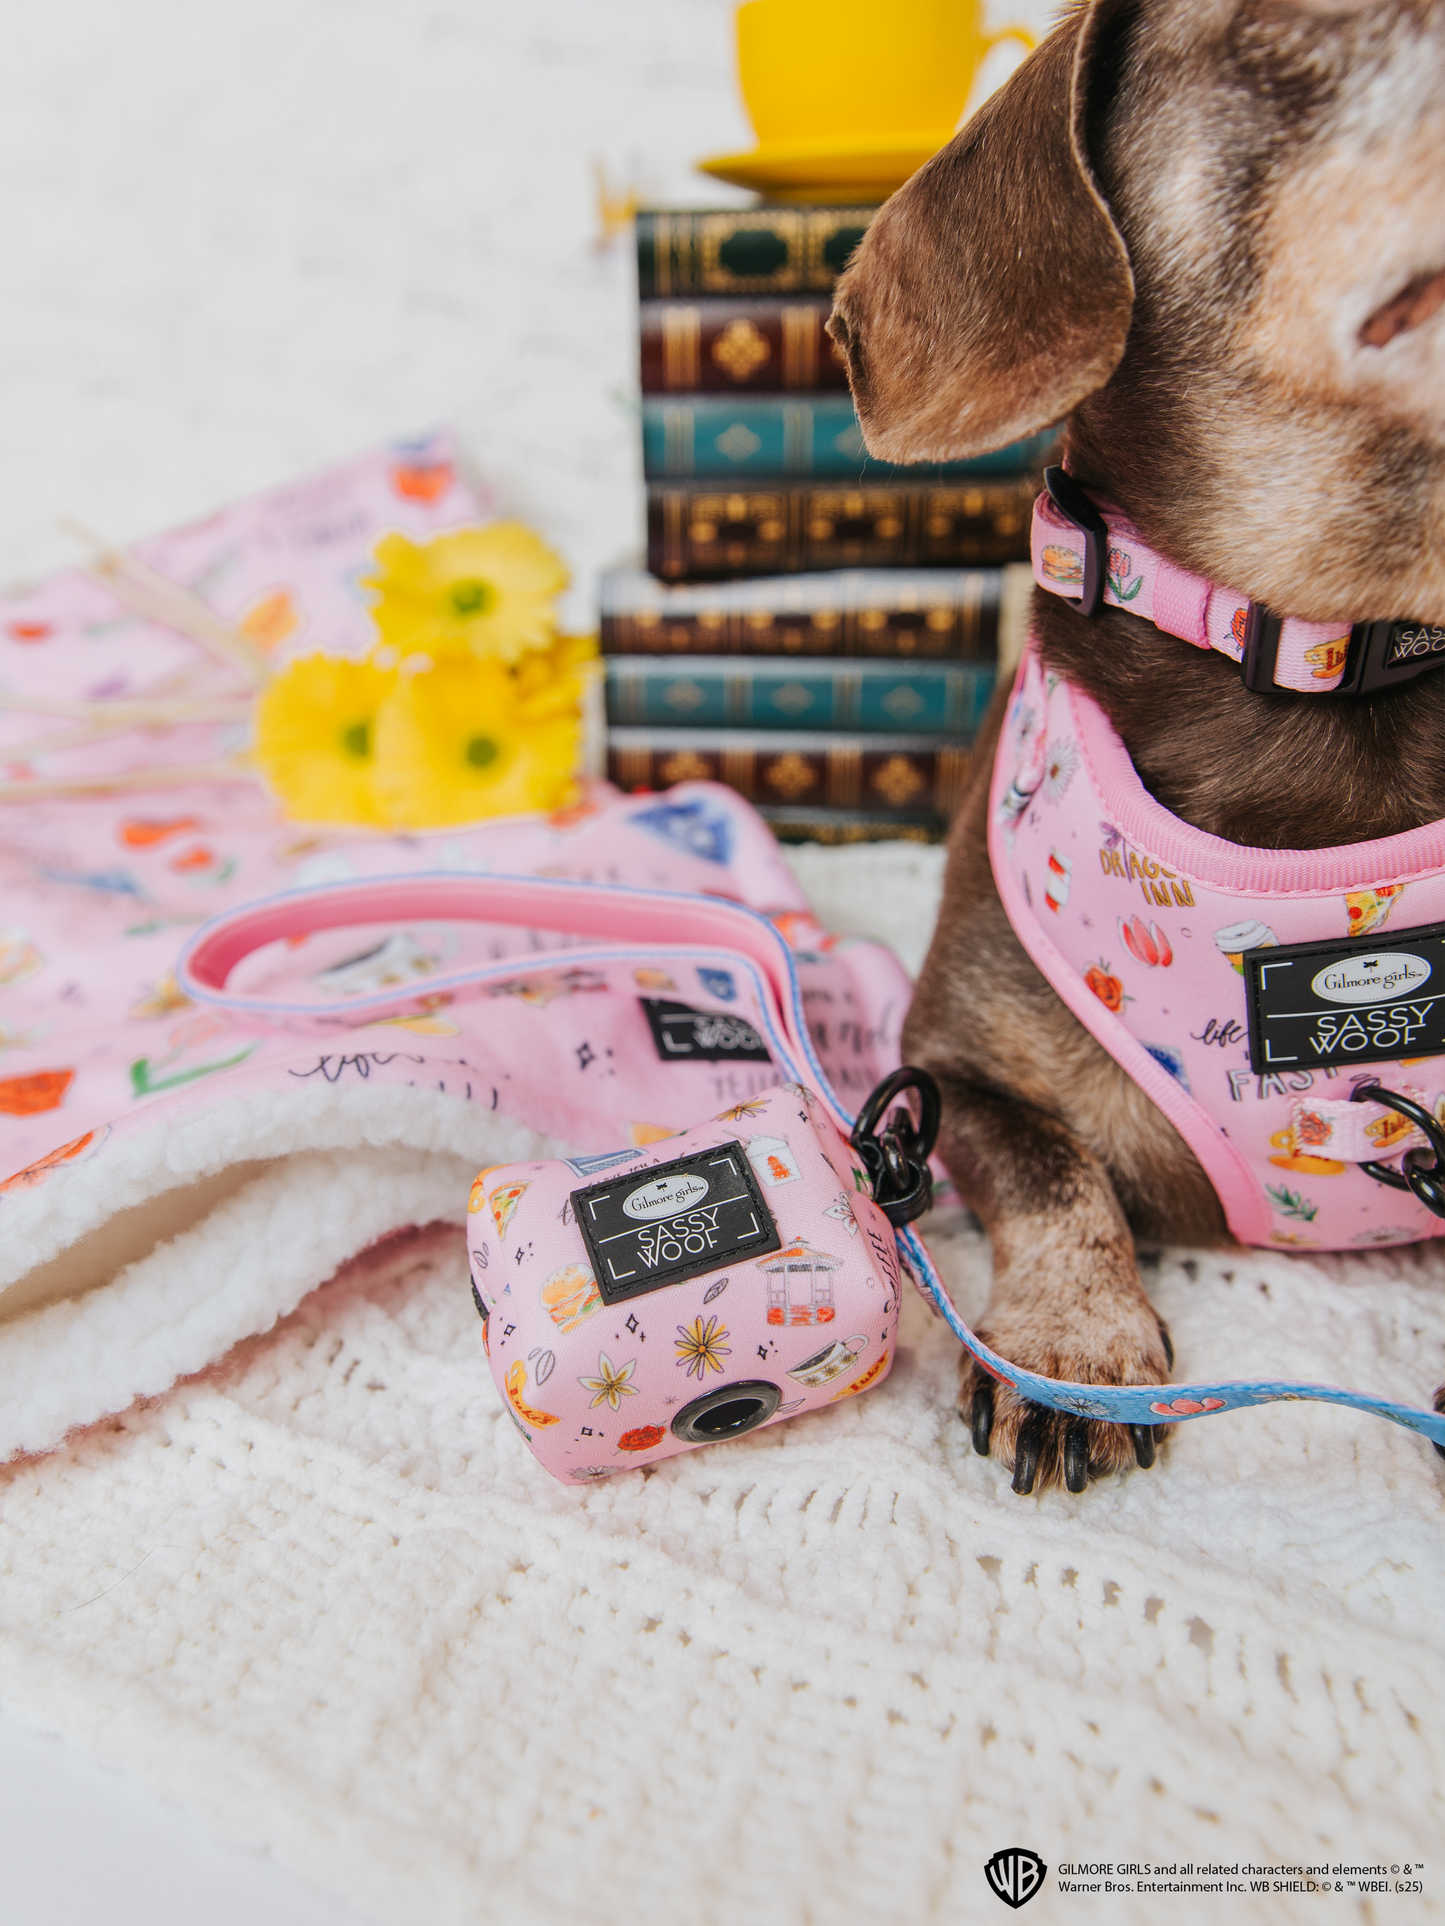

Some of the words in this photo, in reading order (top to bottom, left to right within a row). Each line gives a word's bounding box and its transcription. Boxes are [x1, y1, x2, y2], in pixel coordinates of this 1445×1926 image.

[1400, 626, 1445, 646] SAS
[1141, 880, 1195, 907] INN
[1324, 973, 1381, 990] Gilmore
[1190, 1018, 1249, 1047] life
[1317, 1002, 1434, 1036] SASSY
[692, 1028, 765, 1050] WOO
[1309, 1023, 1426, 1055] WOOF
[631, 1194, 674, 1212] Gilmore
[638, 1207, 718, 1249] SASSY
[637, 1226, 720, 1268] WOOF
